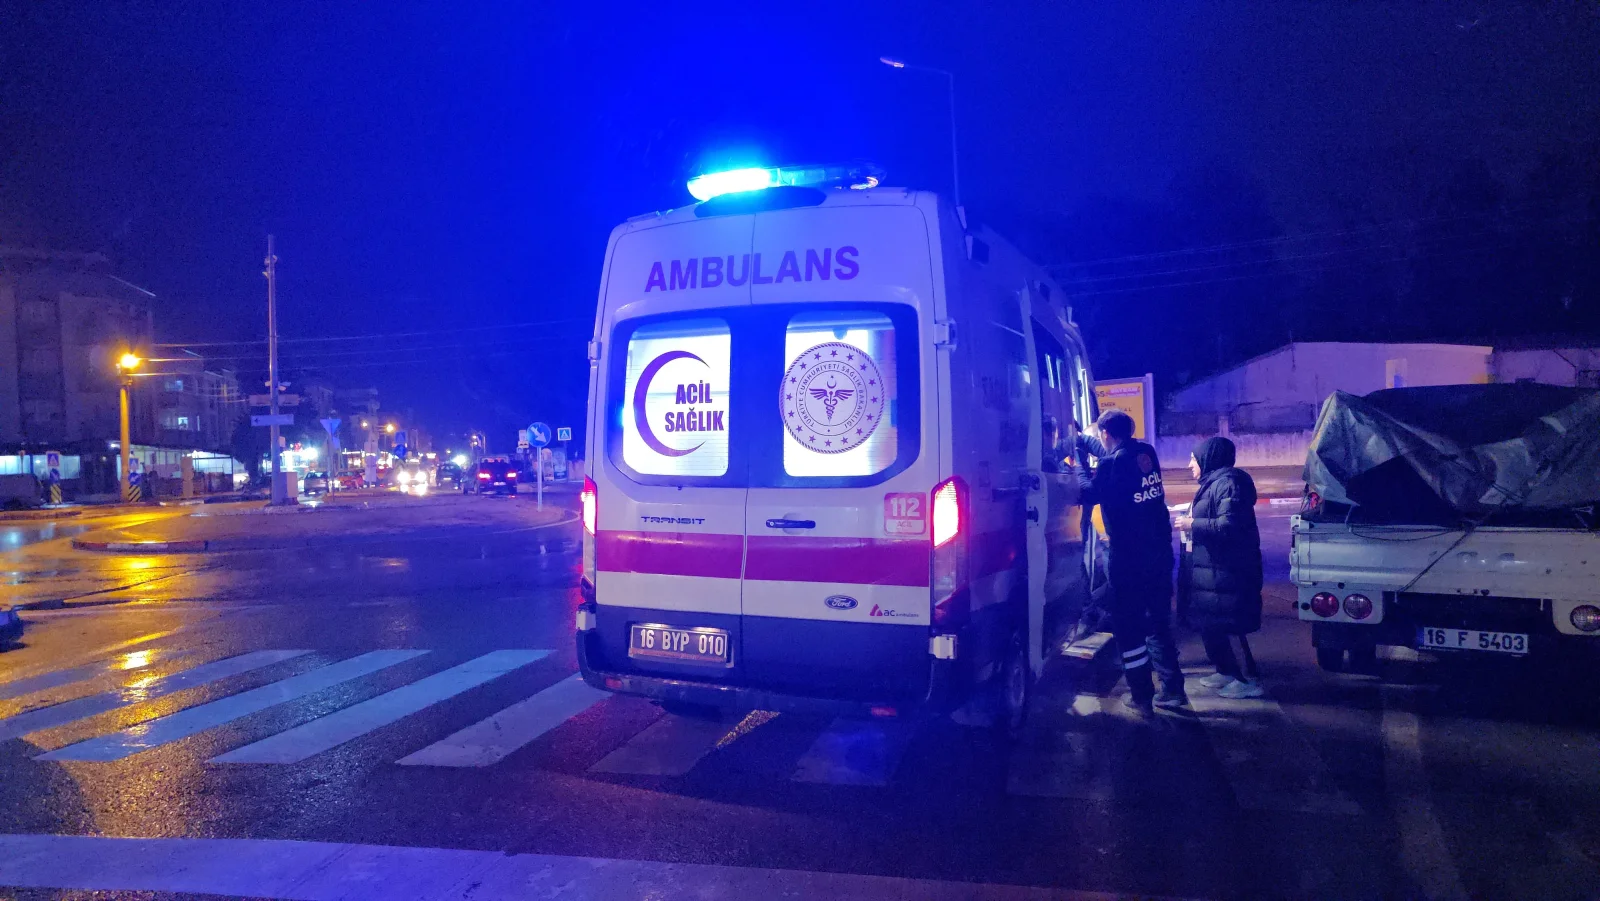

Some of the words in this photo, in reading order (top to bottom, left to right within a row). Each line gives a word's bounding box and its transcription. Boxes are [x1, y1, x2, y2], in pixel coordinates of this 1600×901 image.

[644, 245, 860, 293] AMBULANS
[675, 379, 713, 405] ACİL
[664, 406, 725, 433] SAĞLIK
[1141, 471, 1162, 488] ACİL
[890, 497, 920, 517] 112
[640, 516, 706, 525] TRANSIT
[640, 628, 655, 649] 16
[662, 630, 690, 652] BYP
[698, 634, 724, 656] 010
[1427, 629, 1446, 645] 16
[1458, 631, 1468, 646] F
[1479, 632, 1524, 651] 5403
